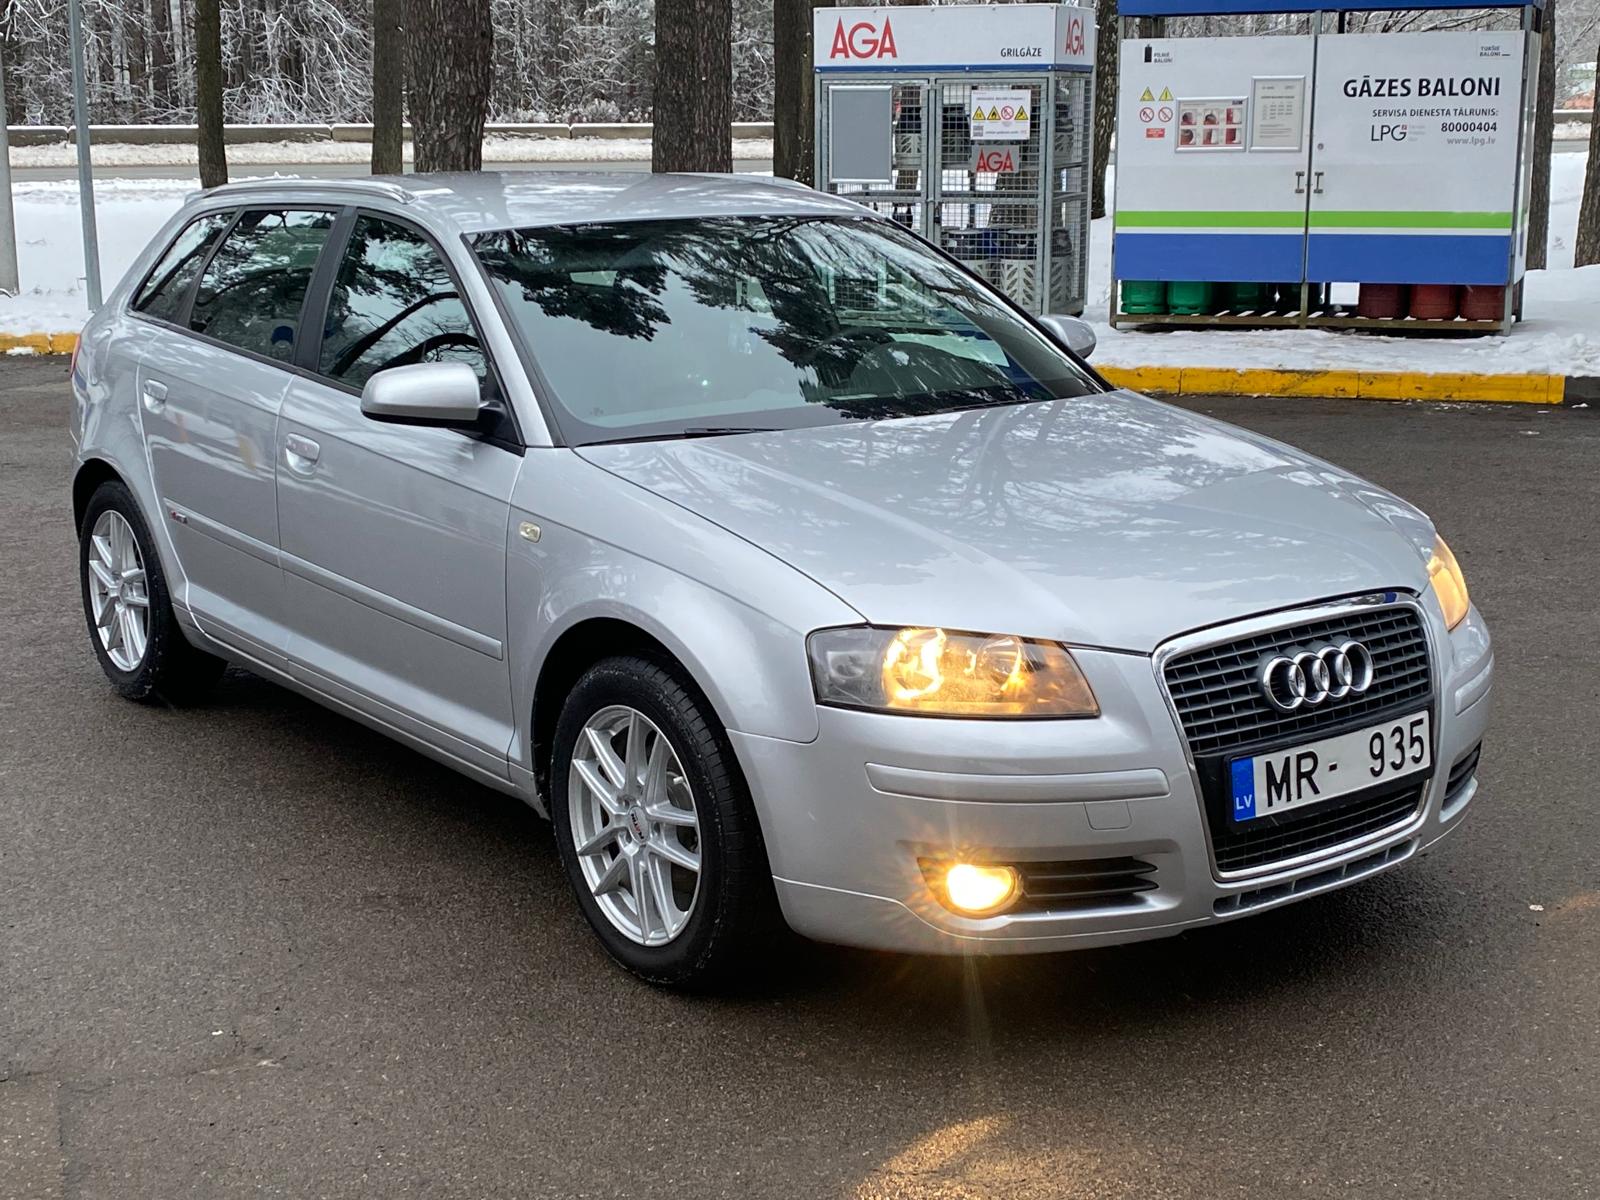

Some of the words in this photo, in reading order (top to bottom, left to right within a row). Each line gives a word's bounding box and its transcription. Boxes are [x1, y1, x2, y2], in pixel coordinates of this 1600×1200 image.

[830, 16, 897, 59] AGA
[1065, 16, 1085, 56] AGA
[1343, 75, 1412, 97] GĀZES
[1418, 77, 1501, 97] BALONI
[1372, 108, 1407, 118] SERVISA
[1410, 108, 1451, 117] DIENESTA
[1453, 107, 1499, 117] TĀLRUNIS:
[1370, 124, 1407, 141] LPG
[1440, 122, 1498, 132] 80000404
[1446, 135, 1496, 147] www.lpg.lv
[976, 147, 1014, 172] AGA
[1369, 717, 1425, 777] 935
[1235, 794, 1253, 811] LV
